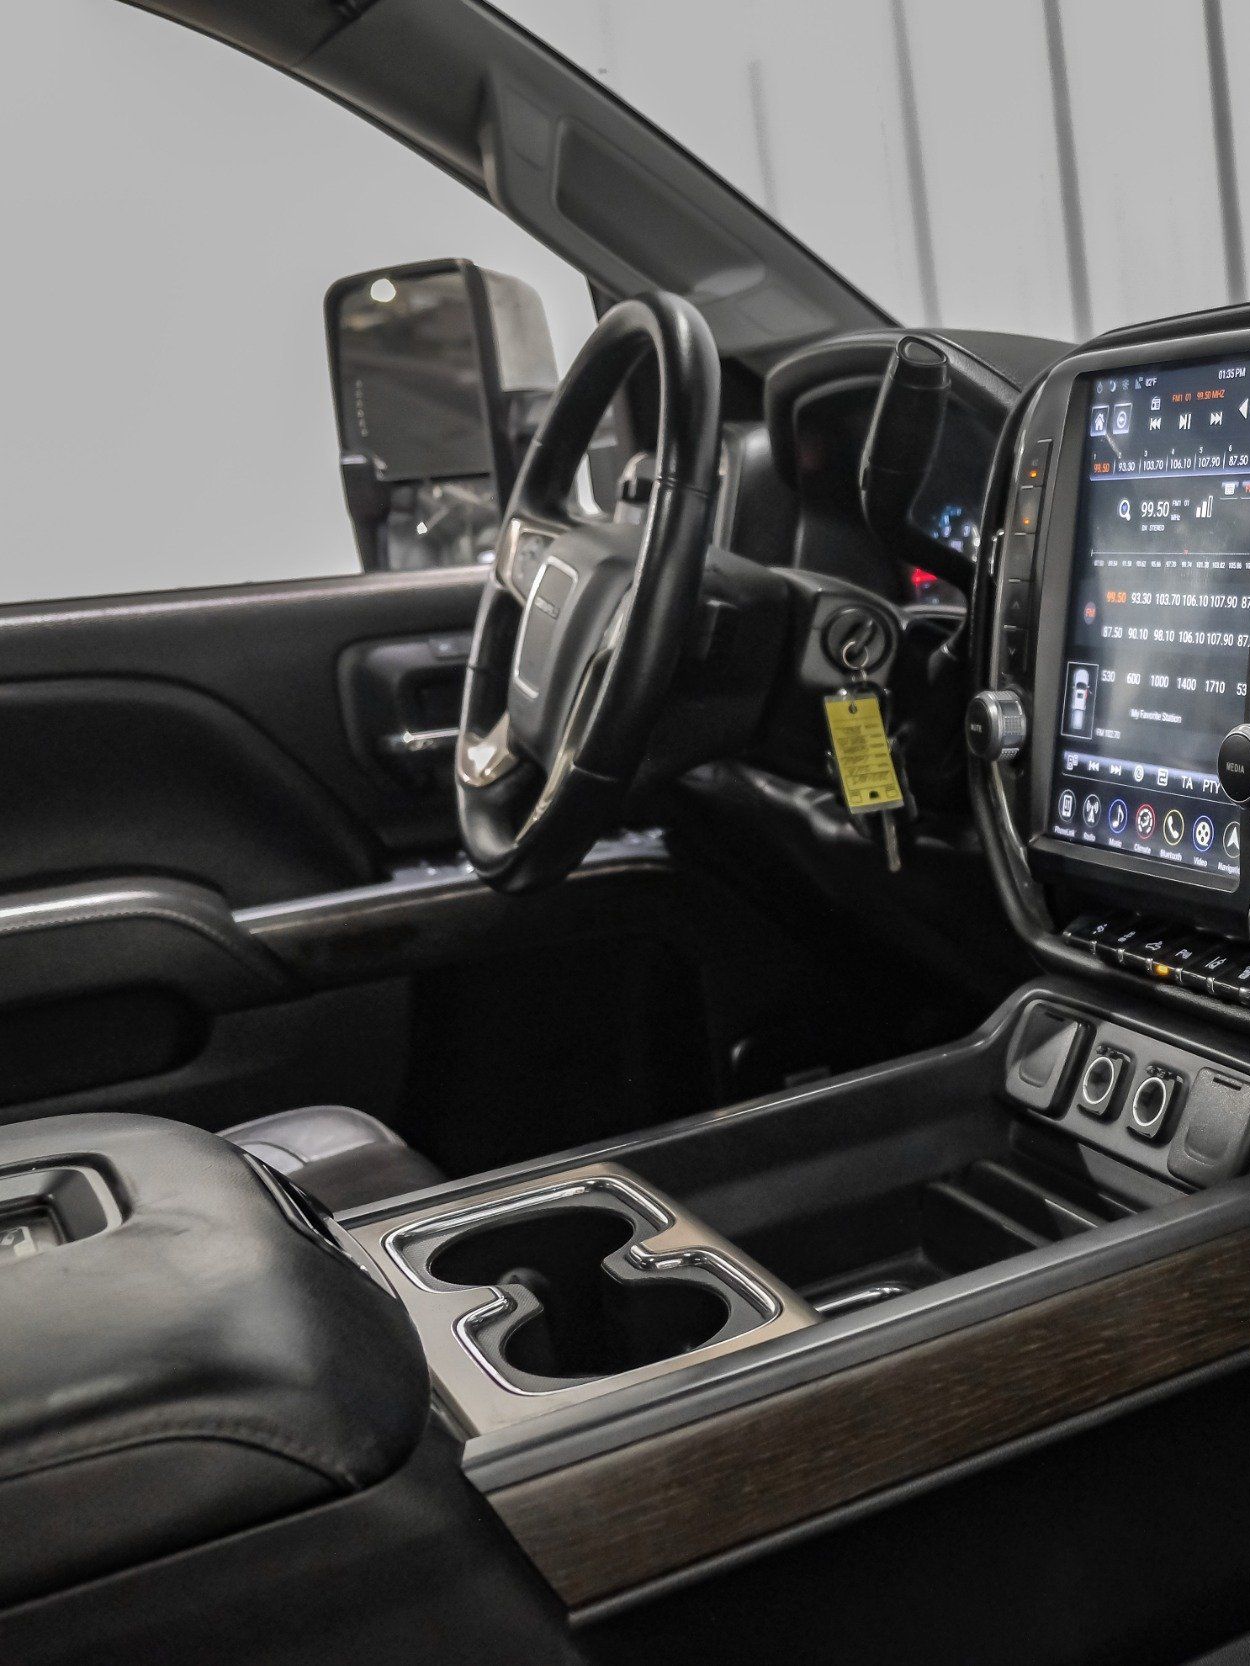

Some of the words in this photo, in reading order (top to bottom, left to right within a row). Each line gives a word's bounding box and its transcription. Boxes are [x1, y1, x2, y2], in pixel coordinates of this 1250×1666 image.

[1218, 369, 1235, 380] 01:35
[1235, 367, 1246, 378] PM
[1196, 390, 1211, 400] 99.50
[1118, 461, 1136, 472] 93.30
[1143, 459, 1164, 471] 103.70
[1170, 458, 1192, 469] 106.10
[1198, 457, 1220, 468] 107.90
[1228, 455, 1249, 466] 87.50
[1141, 501, 1170, 518] 99.50
[1106, 592, 1127, 603] 99.50
[1131, 592, 1152, 604] 93.30
[1155, 593, 1181, 606] 103.70
[1182, 594, 1209, 607] 106.10
[1210, 595, 1238, 609] 107.90
[1103, 626, 1123, 639] 87.50
[1128, 628, 1149, 640] 90.10
[1153, 629, 1175, 642] 98.10
[1178, 630, 1205, 645] 106.10
[1207, 632, 1234, 646] 107.90
[1102, 670, 1116, 683] 530
[1126, 672, 1141, 685] 600
[1150, 675, 1169, 688] 1000
[1177, 677, 1197, 691] 1400
[1205, 680, 1226, 694] 1710
[1130, 709, 1140, 719] My
[1140, 709, 1161, 720] Favorite
[1161, 712, 1182, 723] Station
[1226, 762, 1245, 774] MEDIA
[1182, 776, 1193, 790] TA
[1203, 780, 1220, 794] PTY
[1193, 856, 1208, 867] Video
